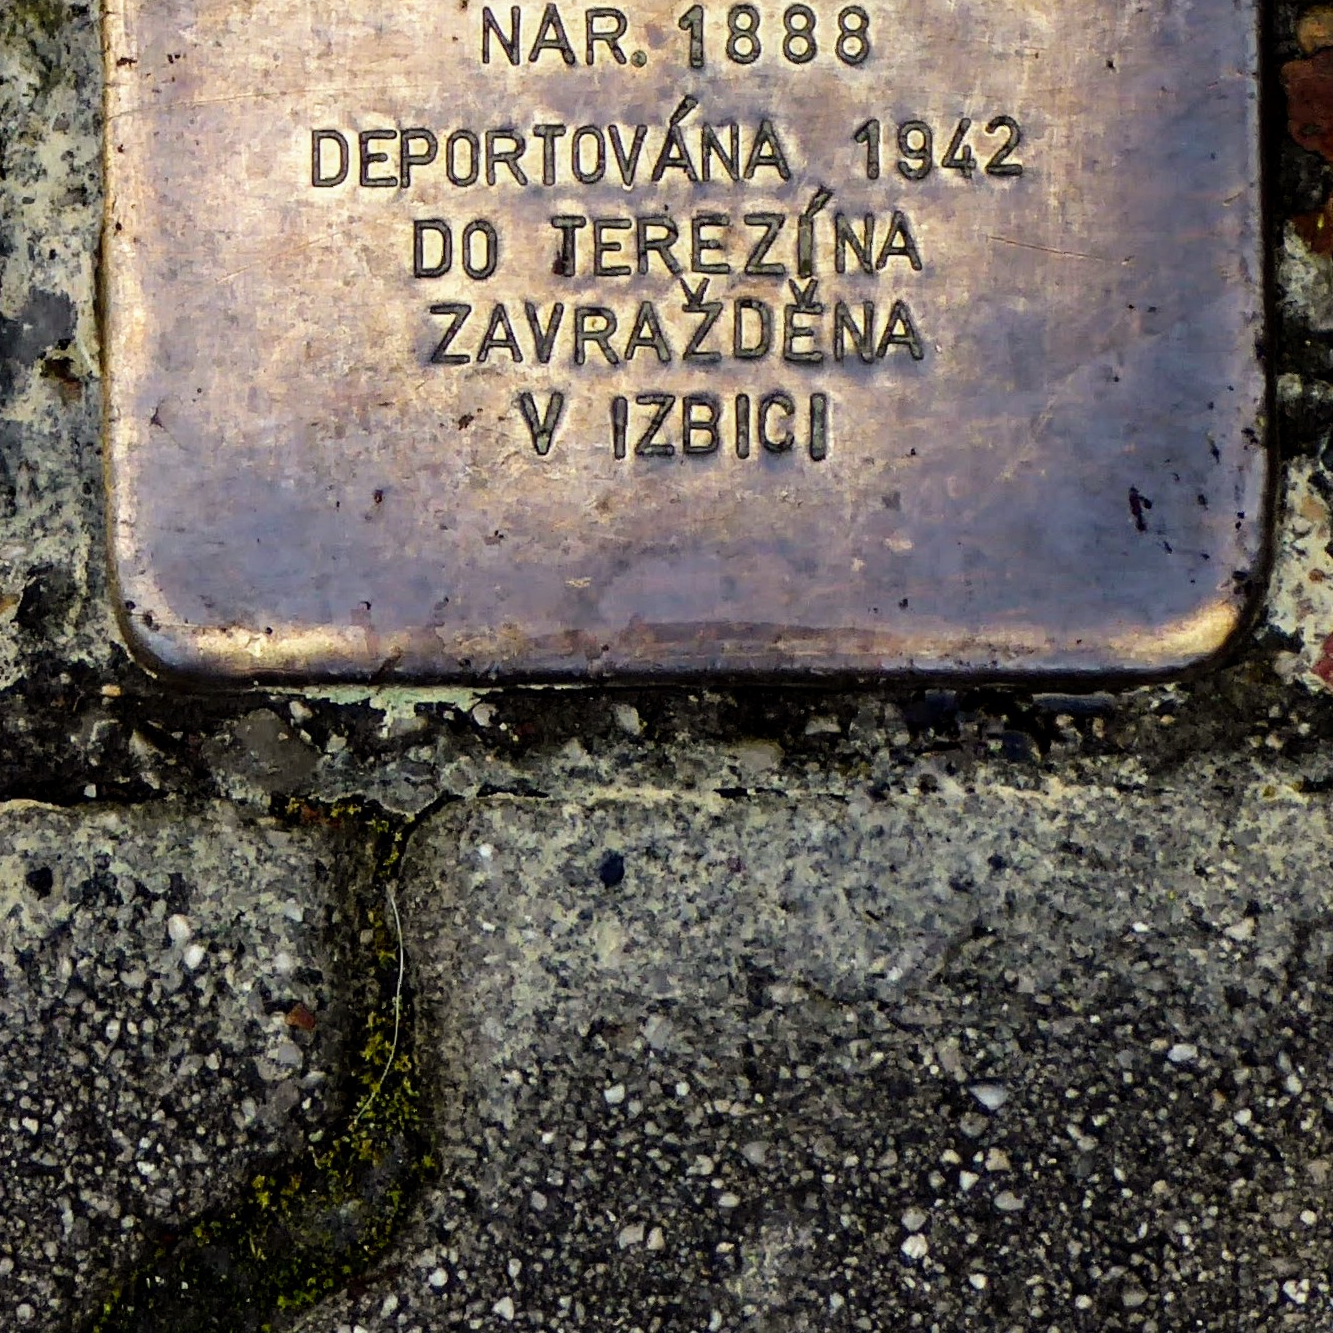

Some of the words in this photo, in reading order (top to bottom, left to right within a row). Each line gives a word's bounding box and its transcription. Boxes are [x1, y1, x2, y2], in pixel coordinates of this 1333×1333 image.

[481, 5, 650, 69] NAR.
[676, 3, 874, 68] 1888
[310, 94, 791, 190] DEPORTOVÁNA
[852, 116, 1025, 181] 1942
[412, 217, 498, 281] DO
[551, 186, 924, 278] TEREZÍNA
[428, 278, 925, 366] ZAVRAŽDĚNA
[520, 392, 564, 459] V
[611, 390, 828, 462] IZBICI
